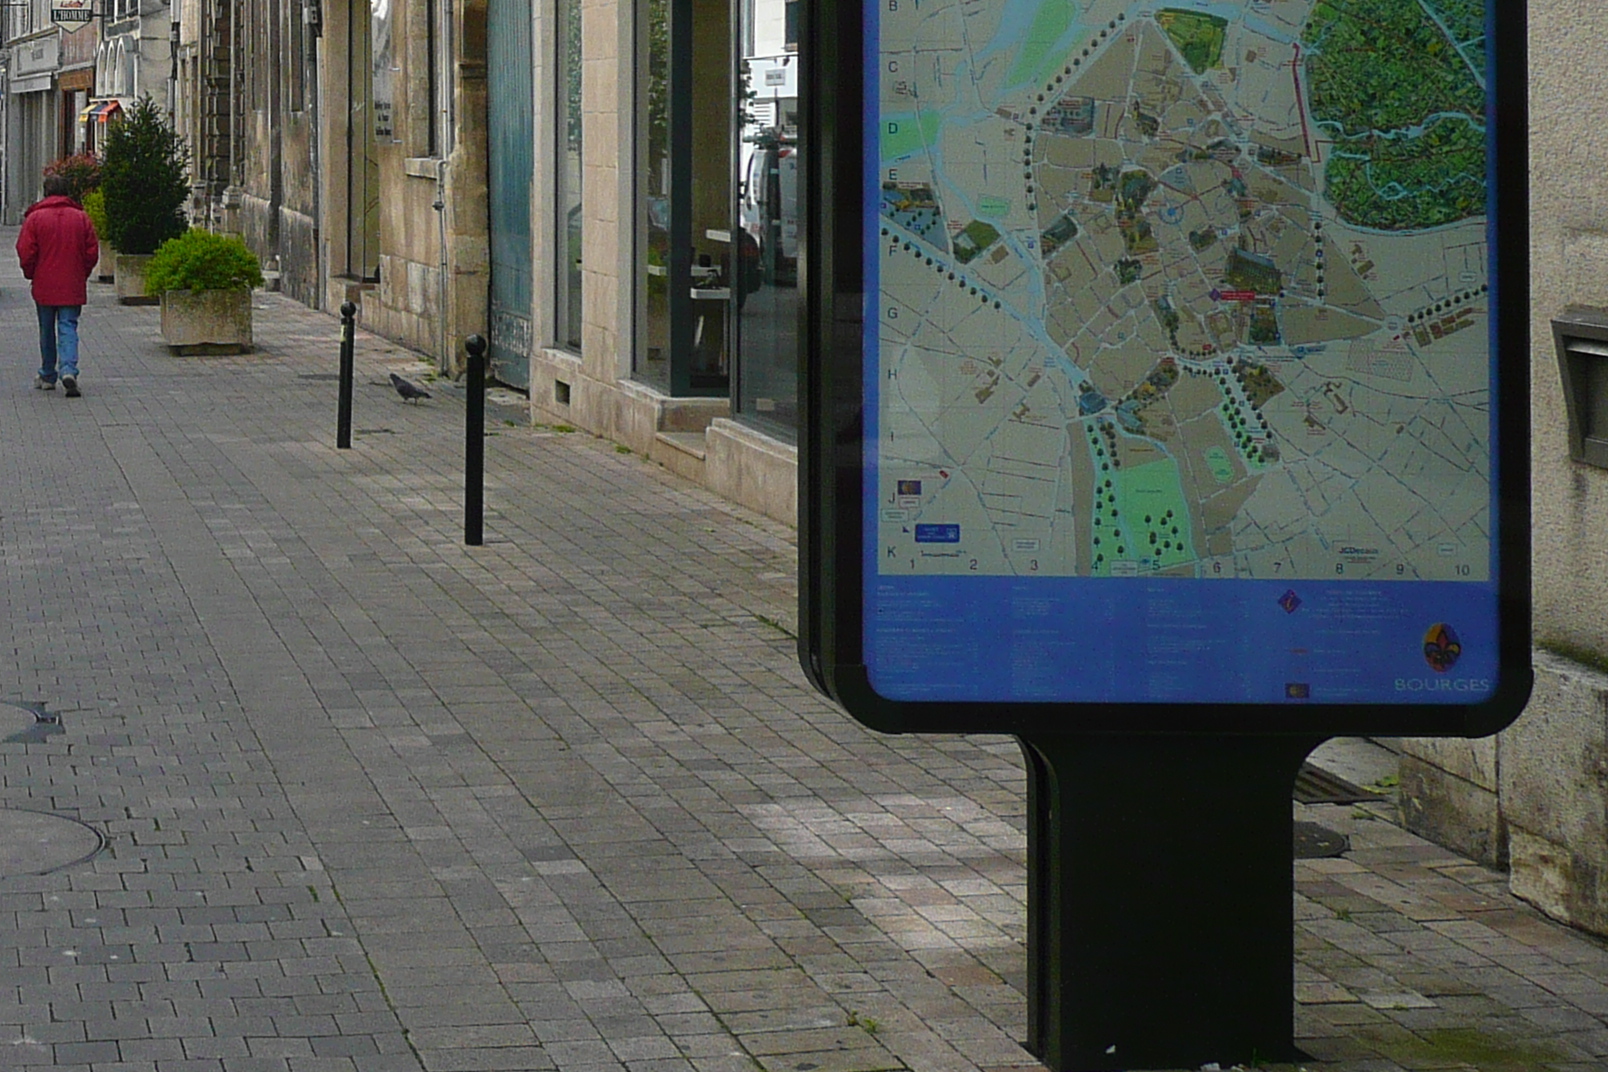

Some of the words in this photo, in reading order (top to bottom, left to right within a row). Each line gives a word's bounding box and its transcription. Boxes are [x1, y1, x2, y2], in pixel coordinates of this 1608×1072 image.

[888, 0, 898, 11] B
[888, 61, 898, 72] C
[888, 123, 898, 134] D
[888, 169, 898, 180] E
[889, 245, 897, 256] F
[887, 307, 898, 319] G
[888, 368, 898, 379] H
[888, 492, 895, 504] J
[887, 546, 896, 558] K
[909, 559, 915, 570] 1
[969, 559, 978, 570] 2
[1030, 559, 1039, 571] 3
[1152, 559, 1161, 571] 5
[1213, 562, 1221, 574] 6
[1273, 562, 1282, 574] 7
[1335, 563, 1344, 574] 8
[1396, 563, 1404, 575] 9
[1454, 564, 1470, 576] 10
[1394, 678, 1490, 692] BOURGES
